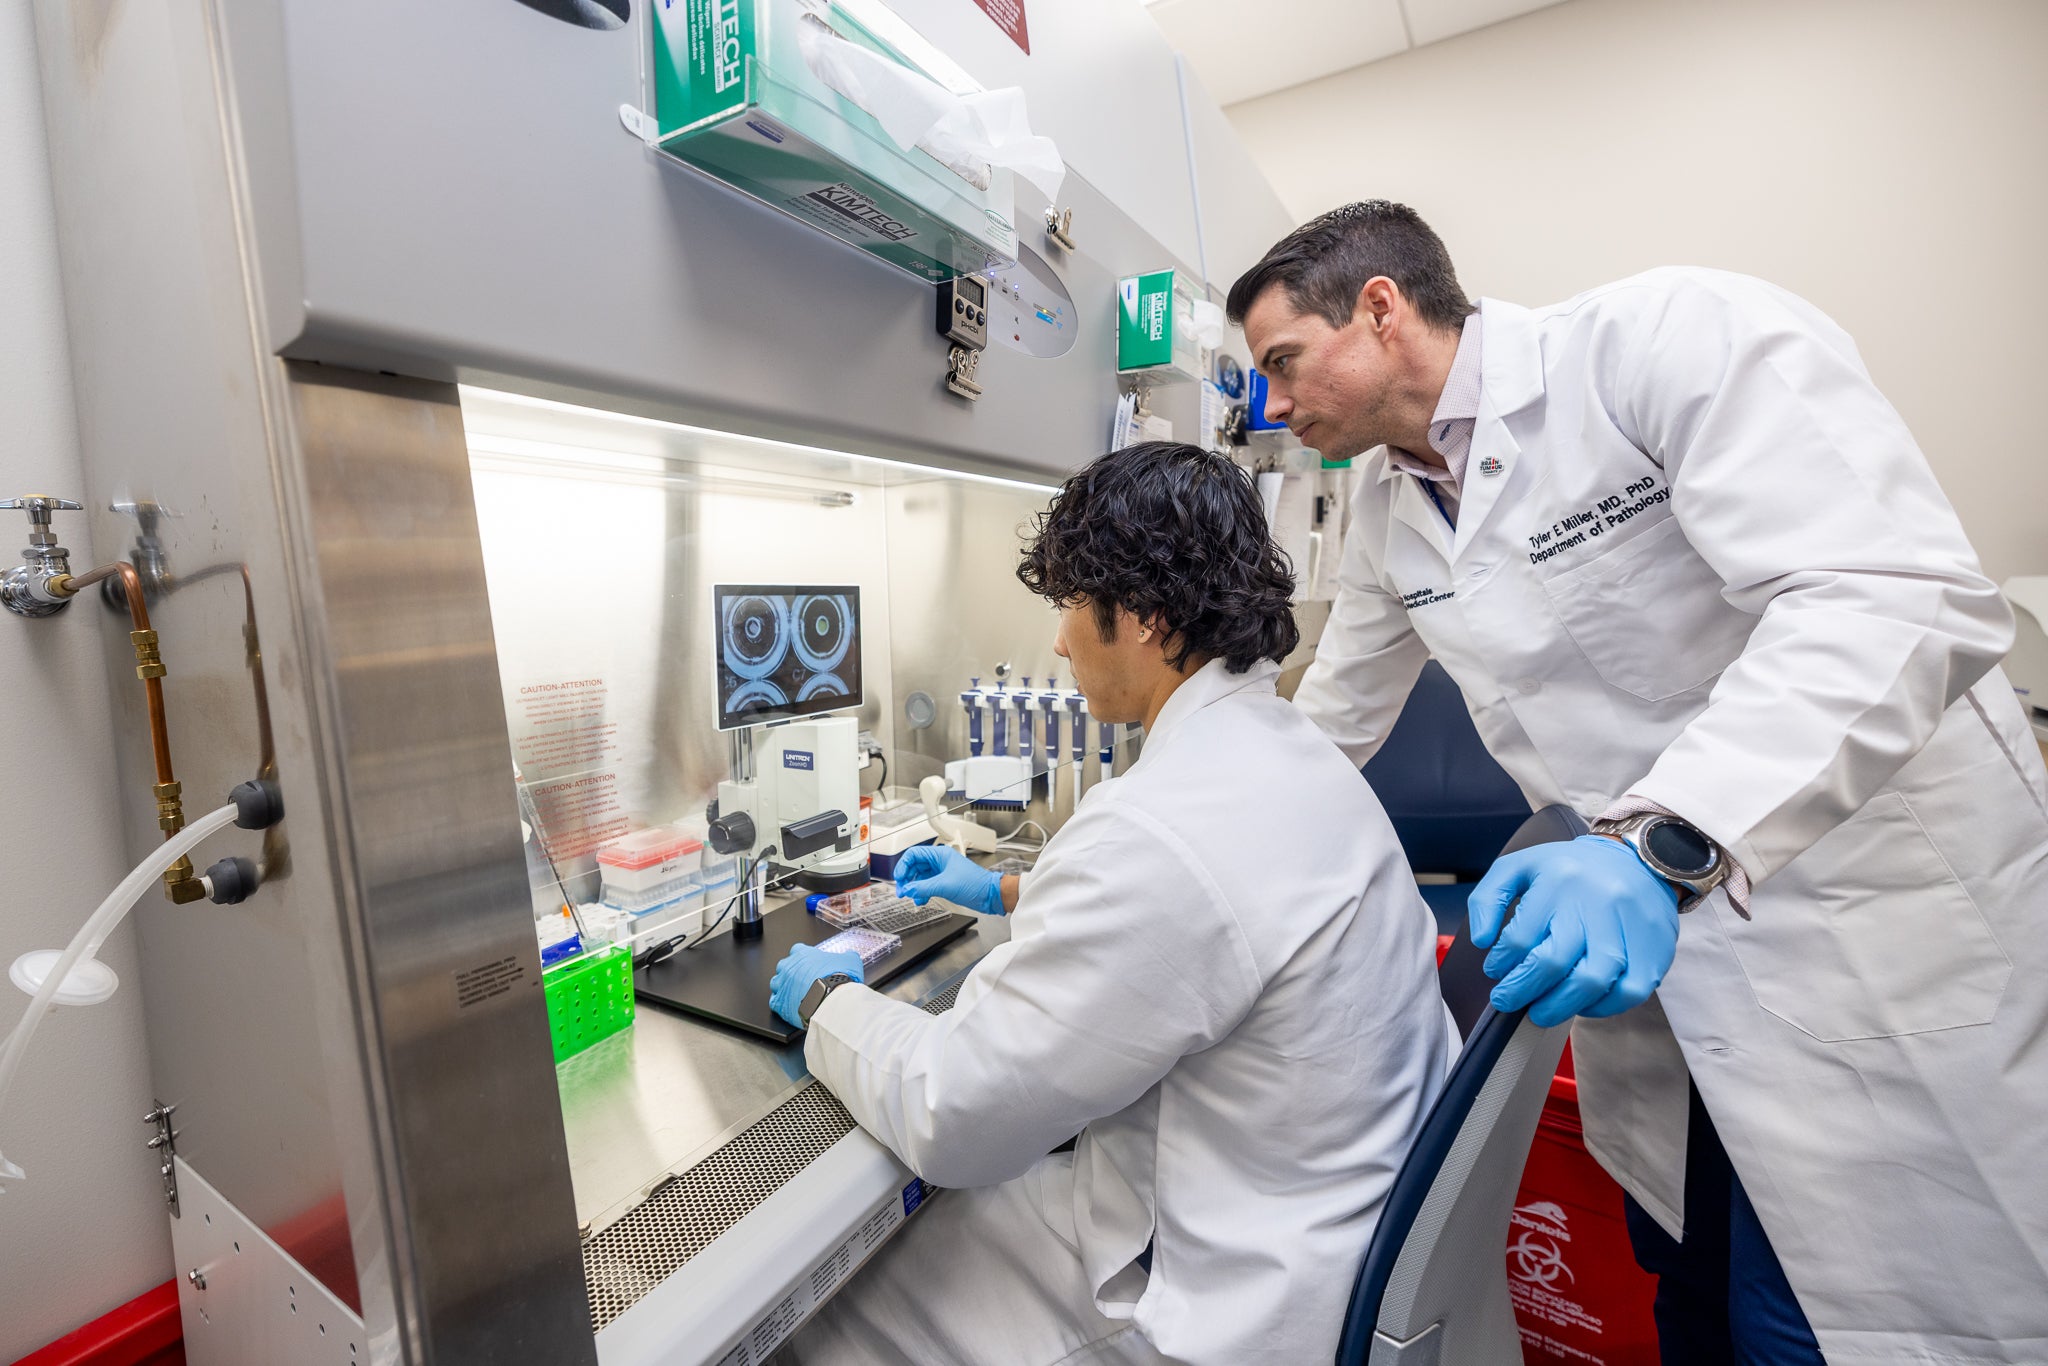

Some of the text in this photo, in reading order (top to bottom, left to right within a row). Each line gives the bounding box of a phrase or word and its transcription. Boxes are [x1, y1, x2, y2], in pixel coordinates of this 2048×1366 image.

[818, 186, 918, 239] KIMTECH
[1154, 292, 1163, 340] KIMTECH
[1529, 530, 1551, 549] Tyler
[1561, 510, 1599, 532] Miller,
[1597, 495, 1626, 514] MD,
[1625, 476, 1655, 498] PhD
[1529, 487, 1671, 564] Department of Pathology
[1429, 591, 1455, 604] Center
[520, 679, 603, 695] CAUTION-ATTENTION
[535, 773, 616, 796] CAUTION-ATTENTION
